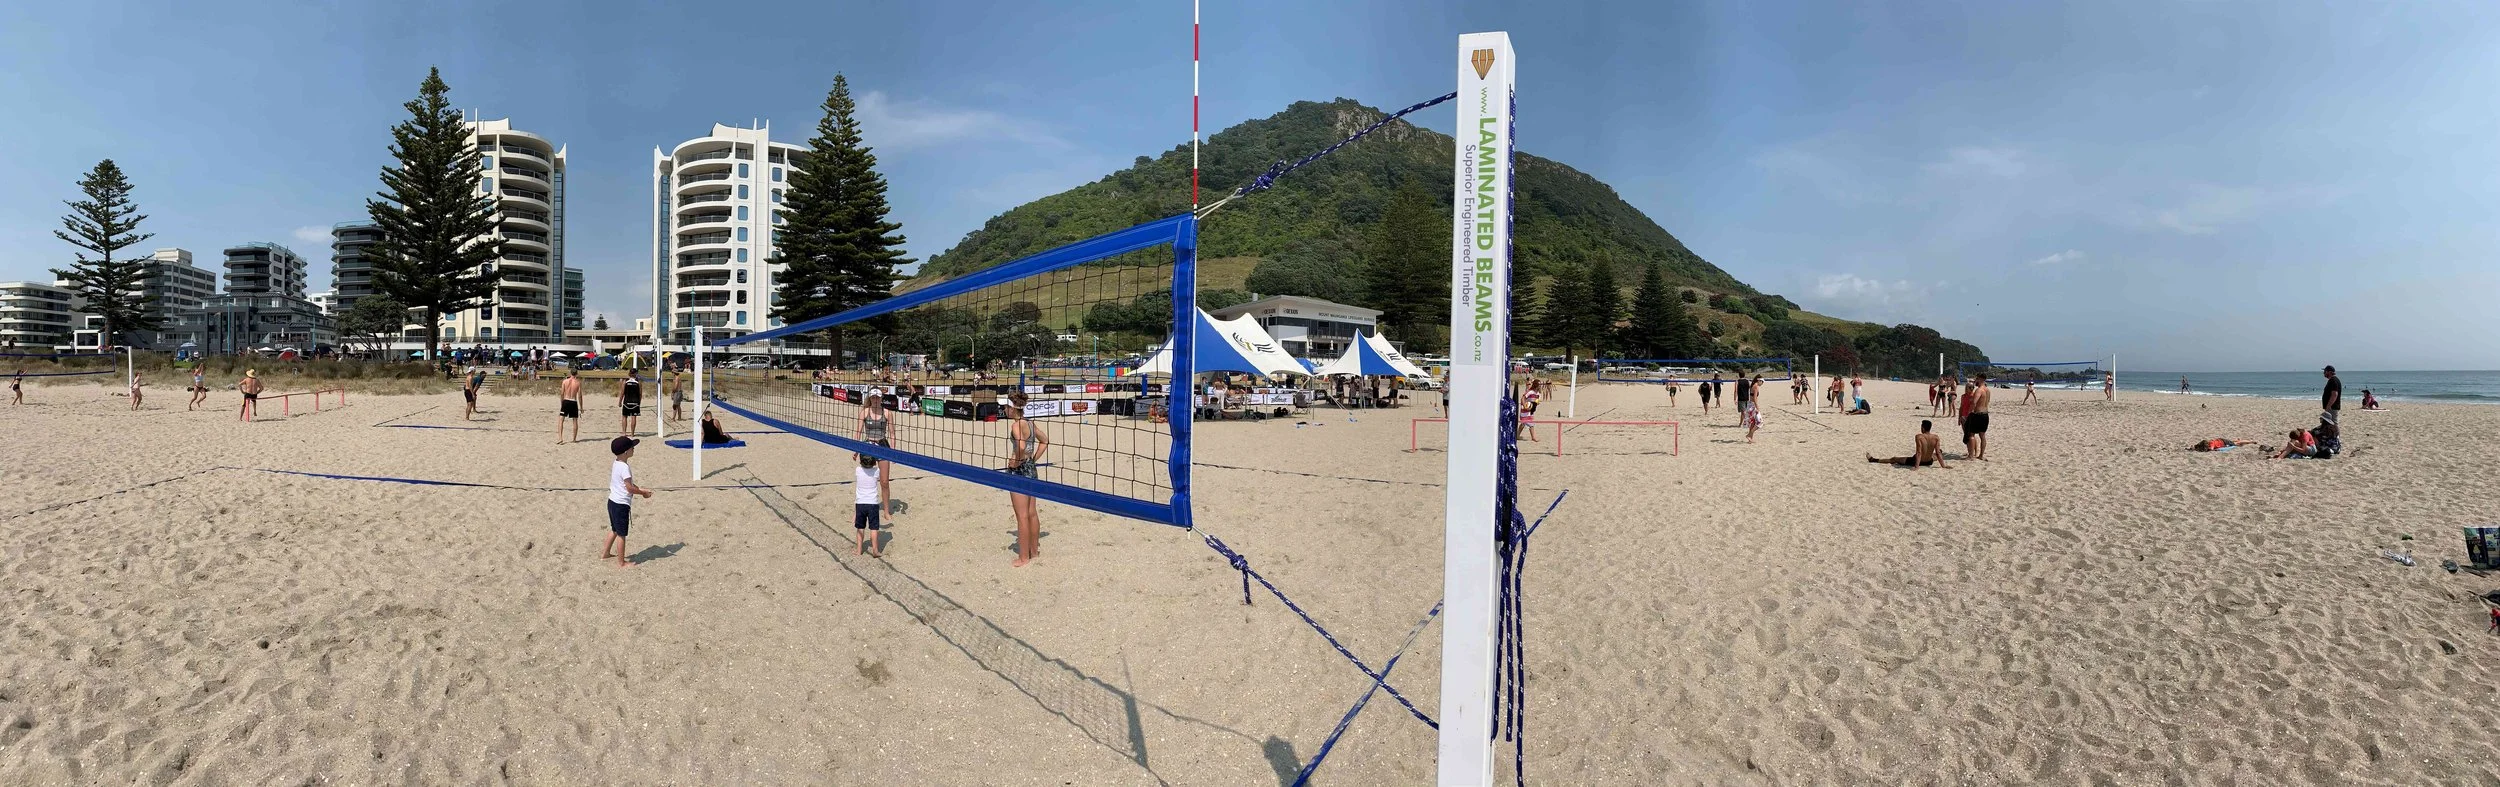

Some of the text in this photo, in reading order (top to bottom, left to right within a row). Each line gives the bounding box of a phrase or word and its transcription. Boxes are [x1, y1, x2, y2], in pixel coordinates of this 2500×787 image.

[1462, 144, 1476, 307] Superior Engineered Timber
[1475, 87, 1496, 361] www.LAMINATED BEAMS.co.nz
[1026, 402, 1055, 410] OOFOS
